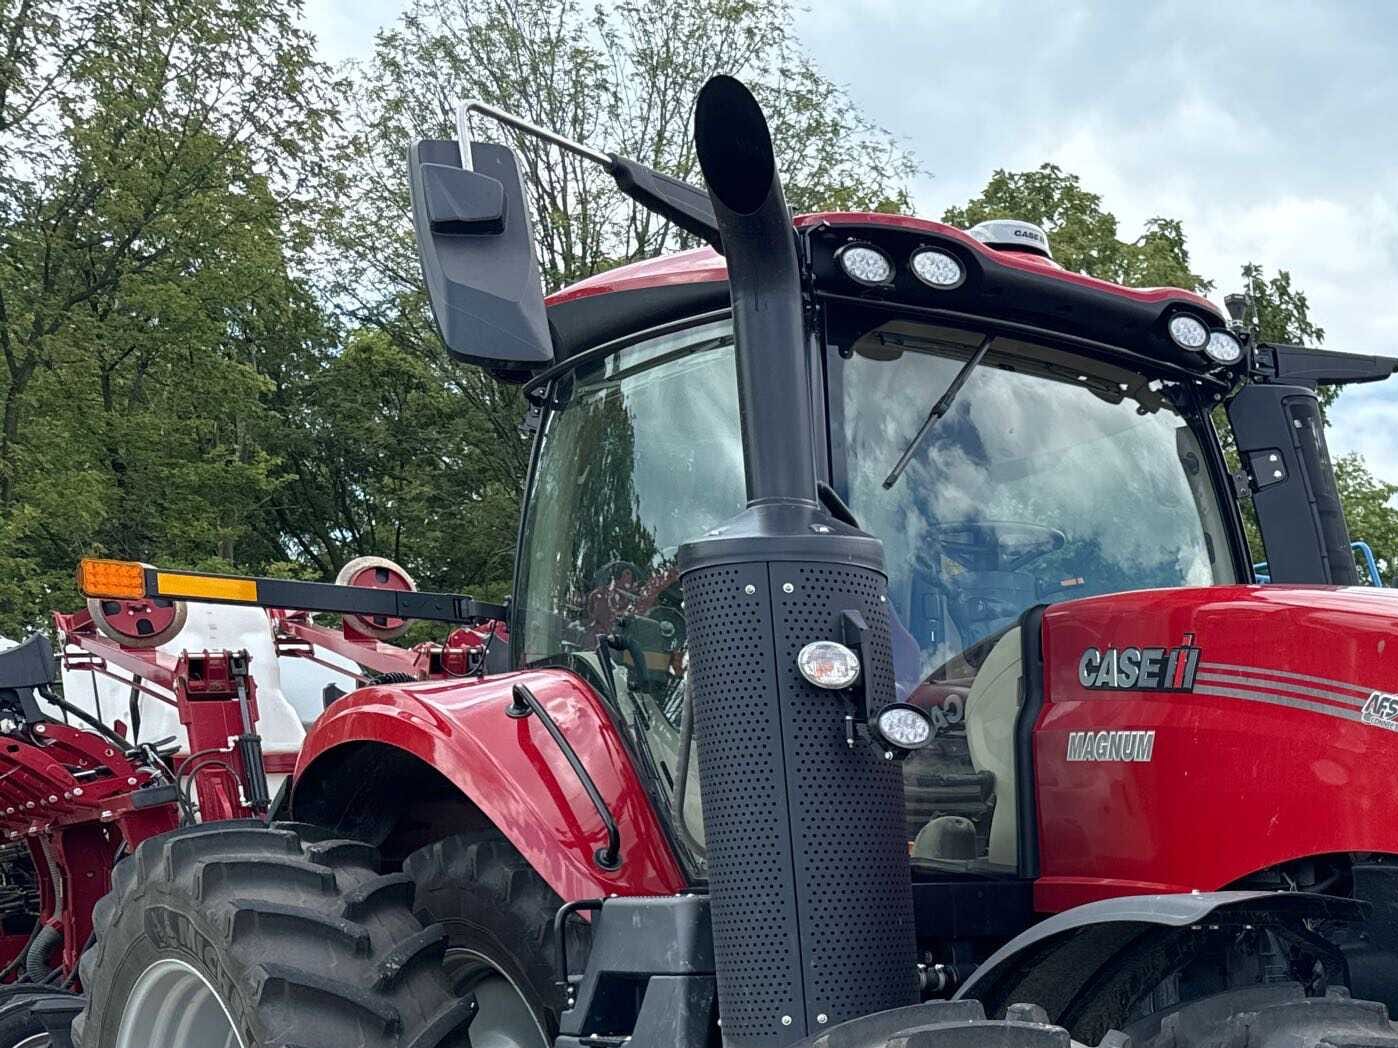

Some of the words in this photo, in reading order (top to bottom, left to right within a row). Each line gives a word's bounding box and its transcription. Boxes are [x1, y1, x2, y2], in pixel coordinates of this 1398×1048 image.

[1014, 229, 1039, 241] CASE
[1078, 647, 1164, 689] CASE
[1066, 730, 1156, 762] MAGNUM
